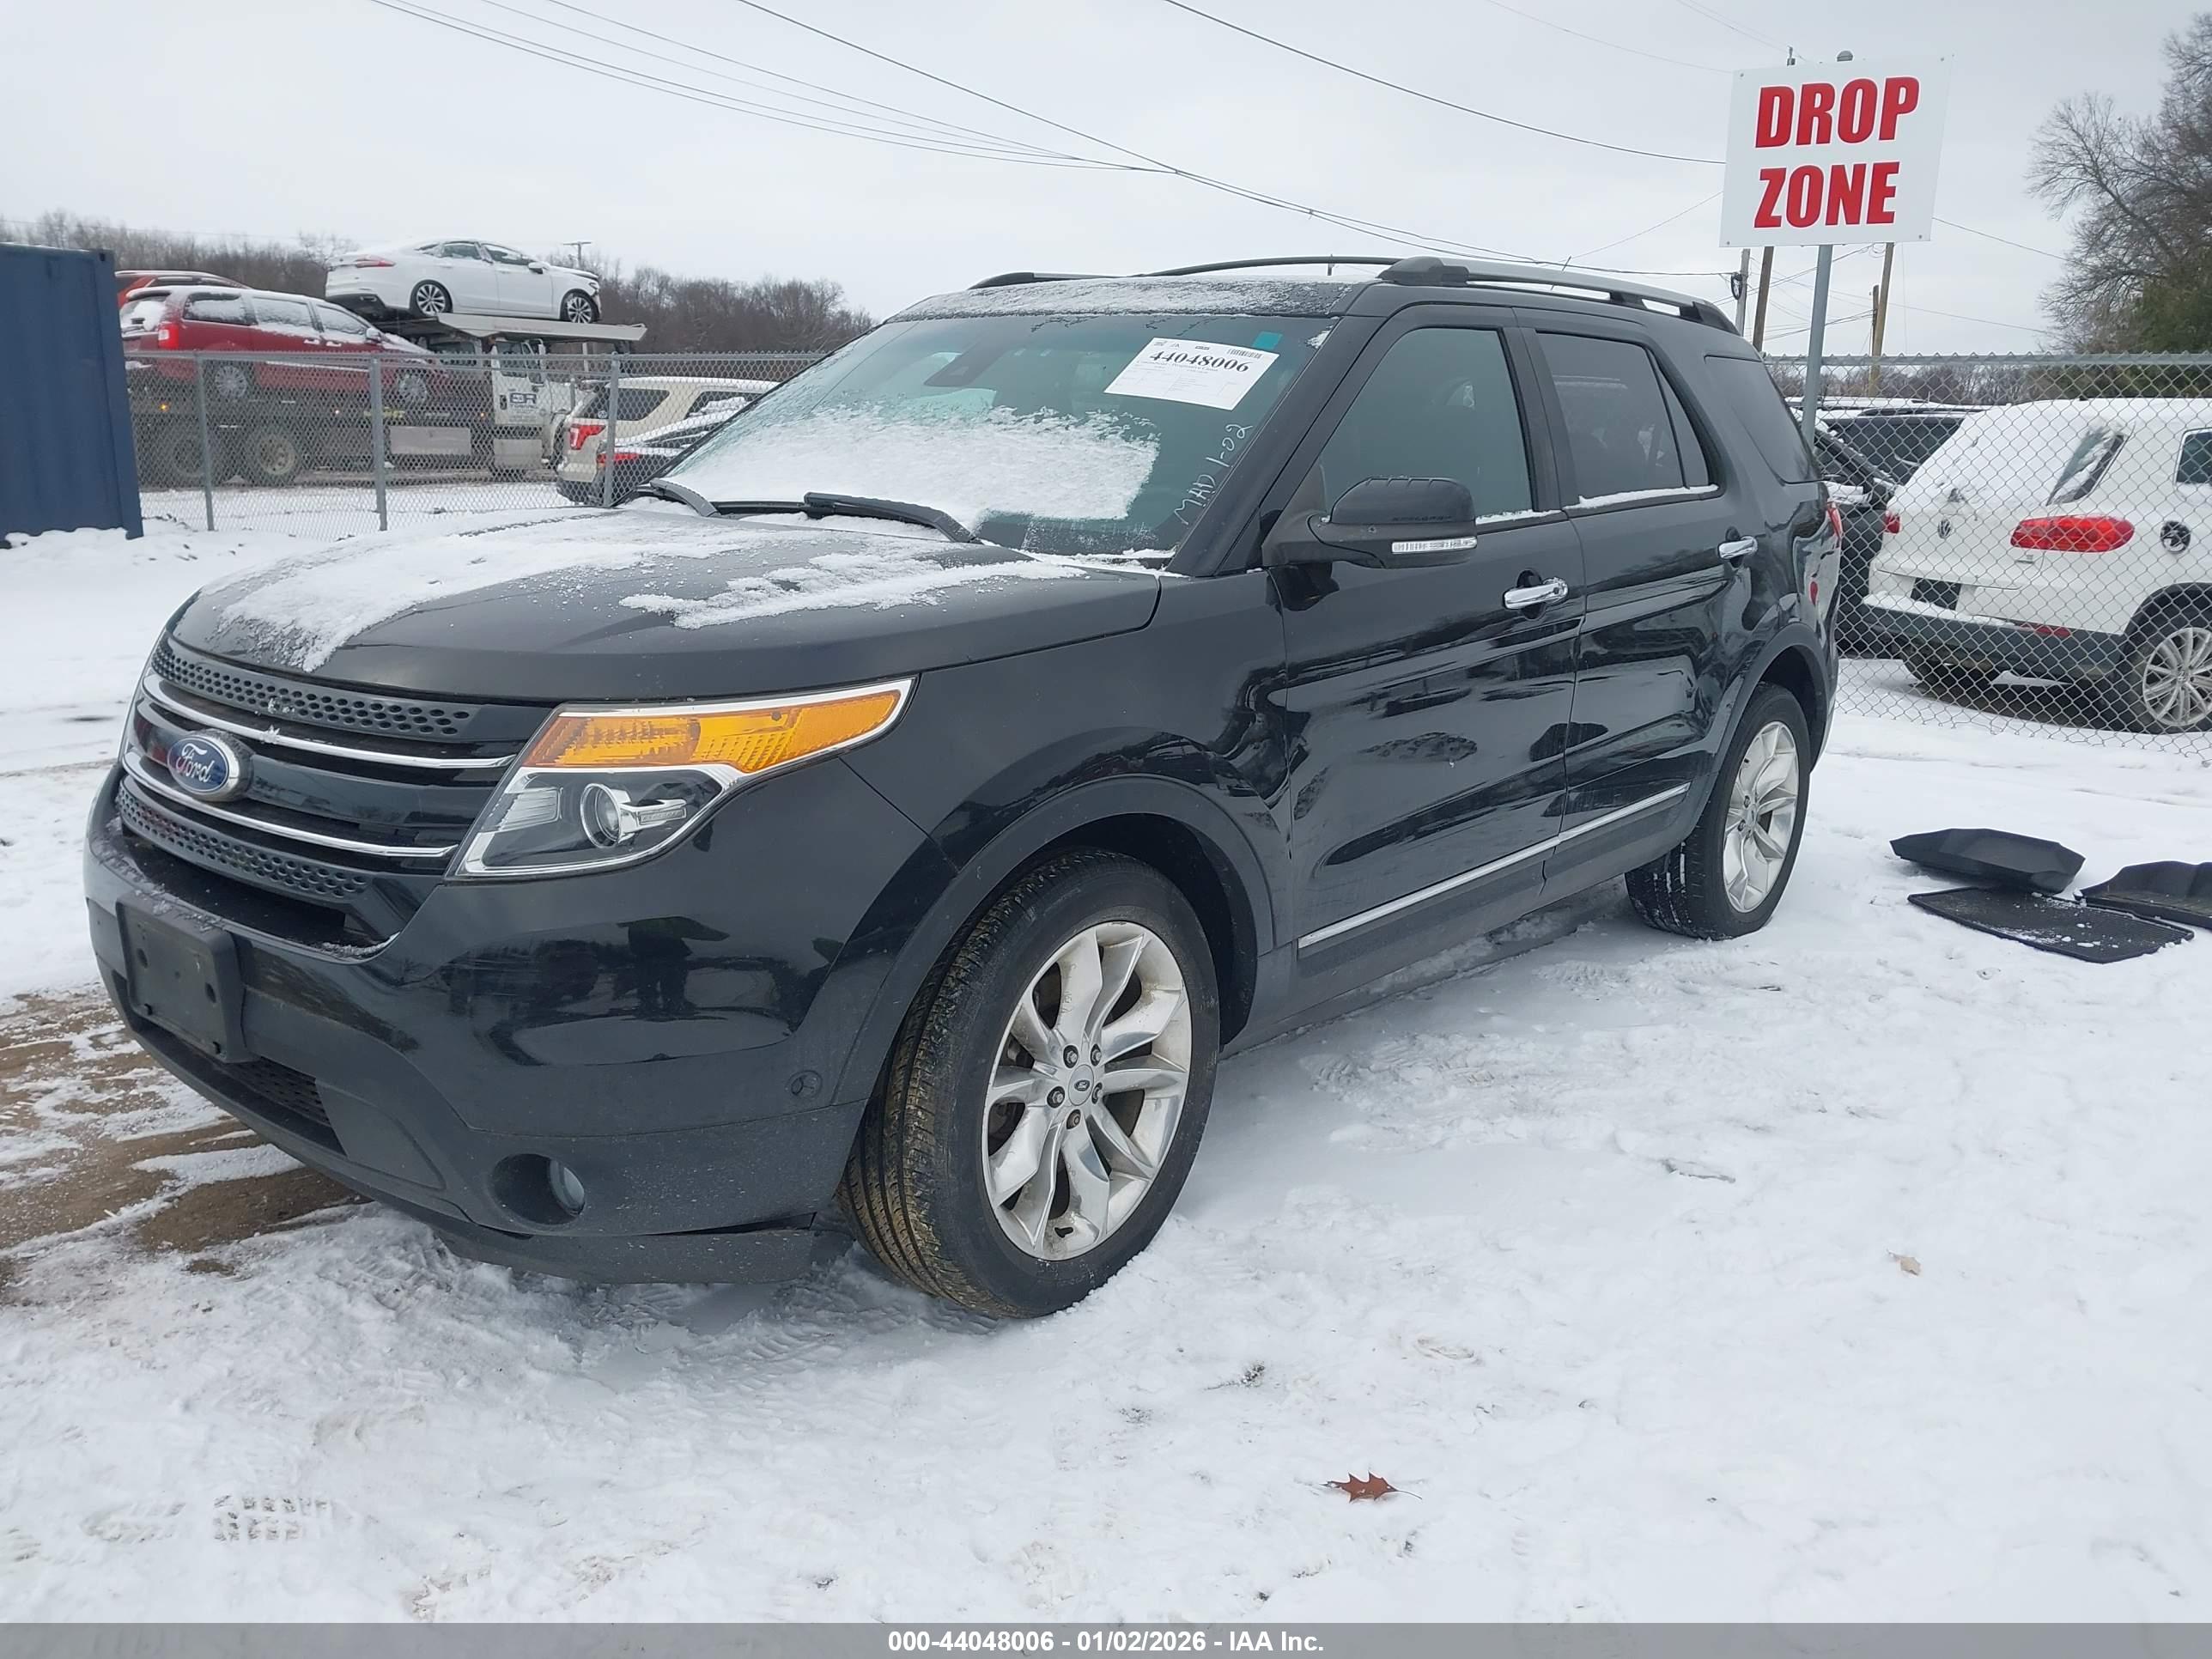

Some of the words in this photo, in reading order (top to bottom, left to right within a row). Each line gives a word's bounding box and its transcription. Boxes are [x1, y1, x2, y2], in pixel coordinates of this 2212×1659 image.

[1754, 76, 1920, 149] DROP
[1753, 161, 1900, 228] ZONE
[1149, 350, 1254, 373] 44048006
[175, 743, 216, 783] Ford
